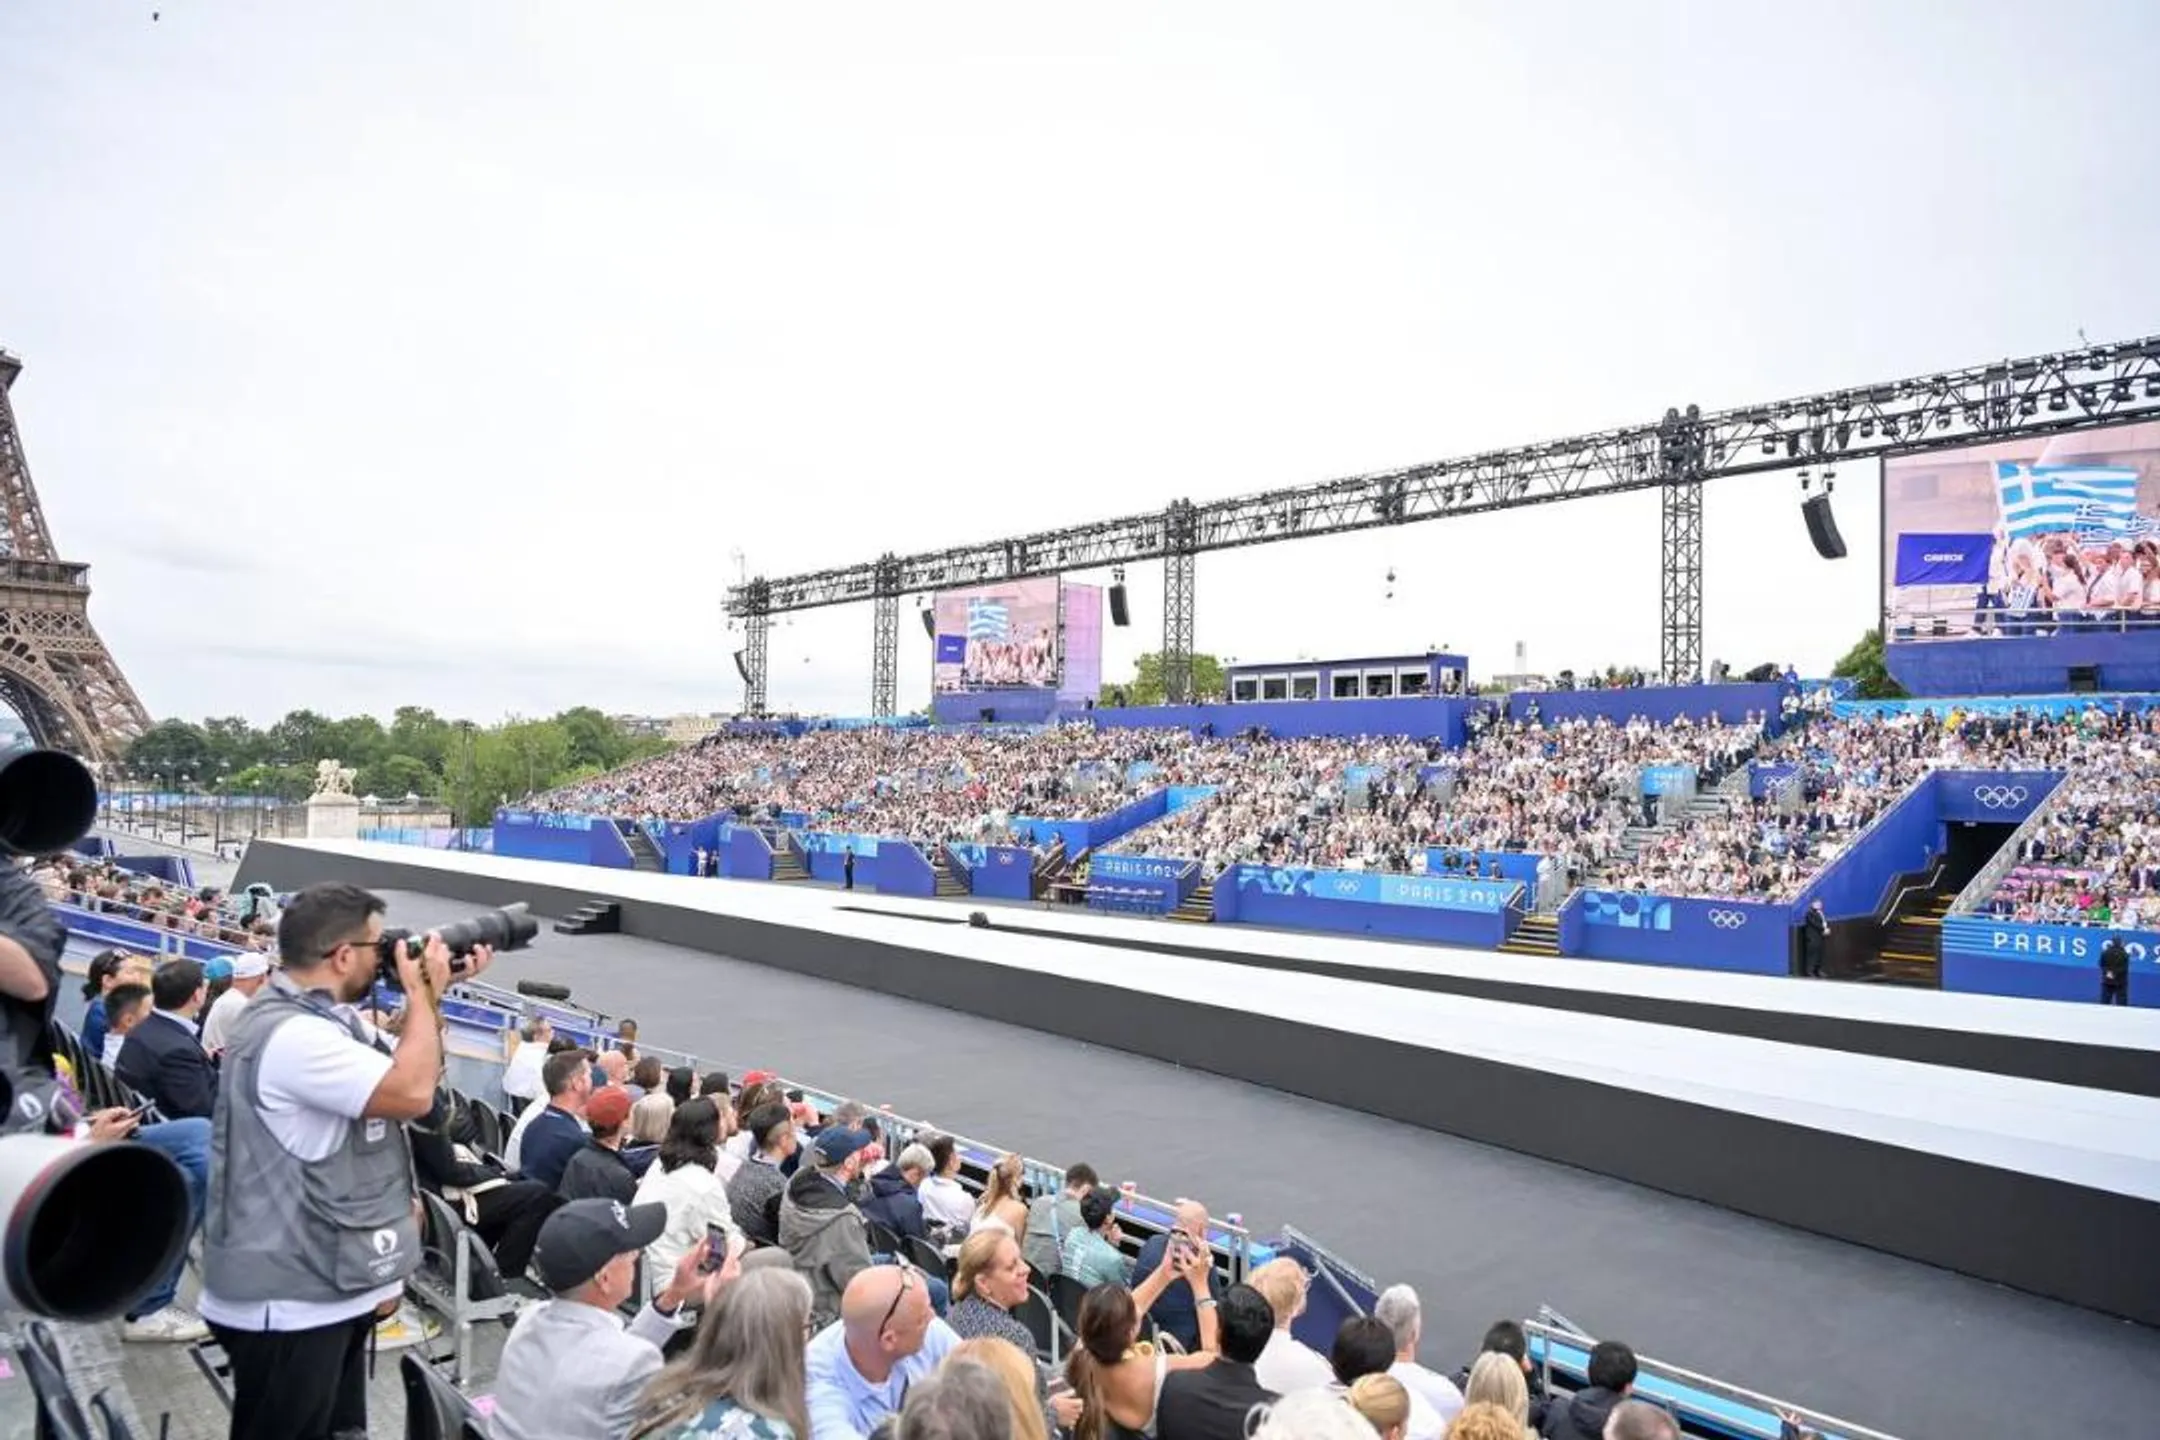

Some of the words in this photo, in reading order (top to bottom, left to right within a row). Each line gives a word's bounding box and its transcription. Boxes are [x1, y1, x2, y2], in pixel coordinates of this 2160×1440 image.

[1104, 861, 1142, 876] PARIS
[1398, 883, 1452, 902] PARIS
[1993, 931, 2087, 957] PARIS
